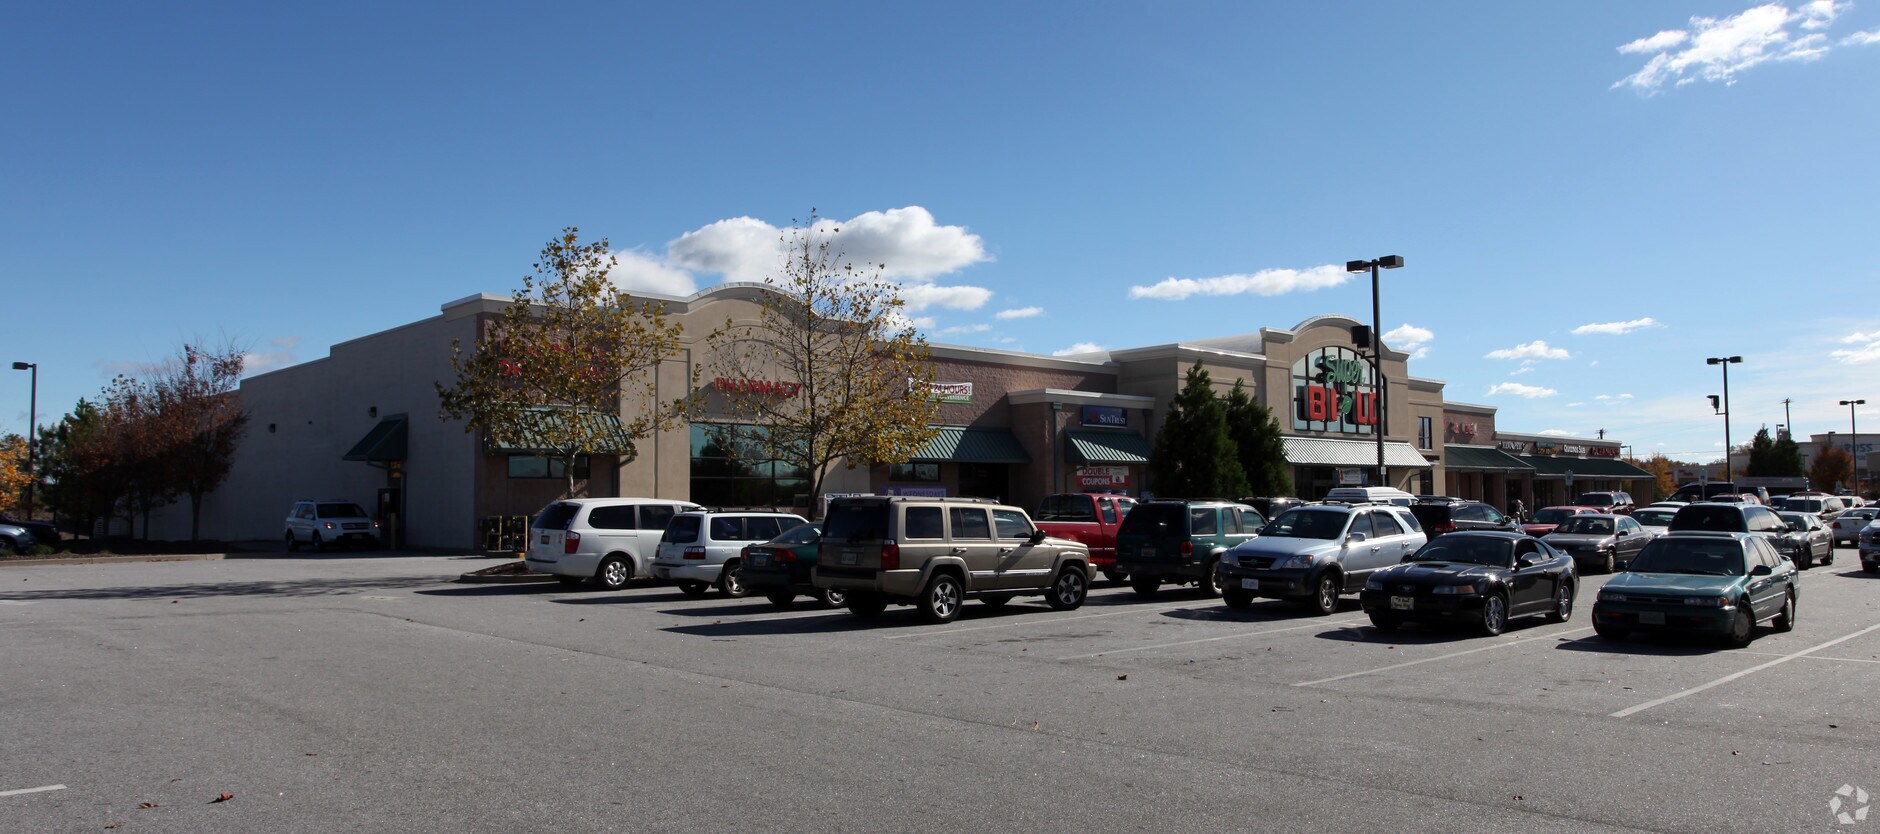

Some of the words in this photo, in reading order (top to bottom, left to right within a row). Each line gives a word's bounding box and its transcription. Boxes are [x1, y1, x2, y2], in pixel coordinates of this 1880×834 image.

[1325, 354, 1366, 393] Super
[1082, 467, 1110, 476] DOUBLE
[1082, 477, 1110, 486] COUPONS
